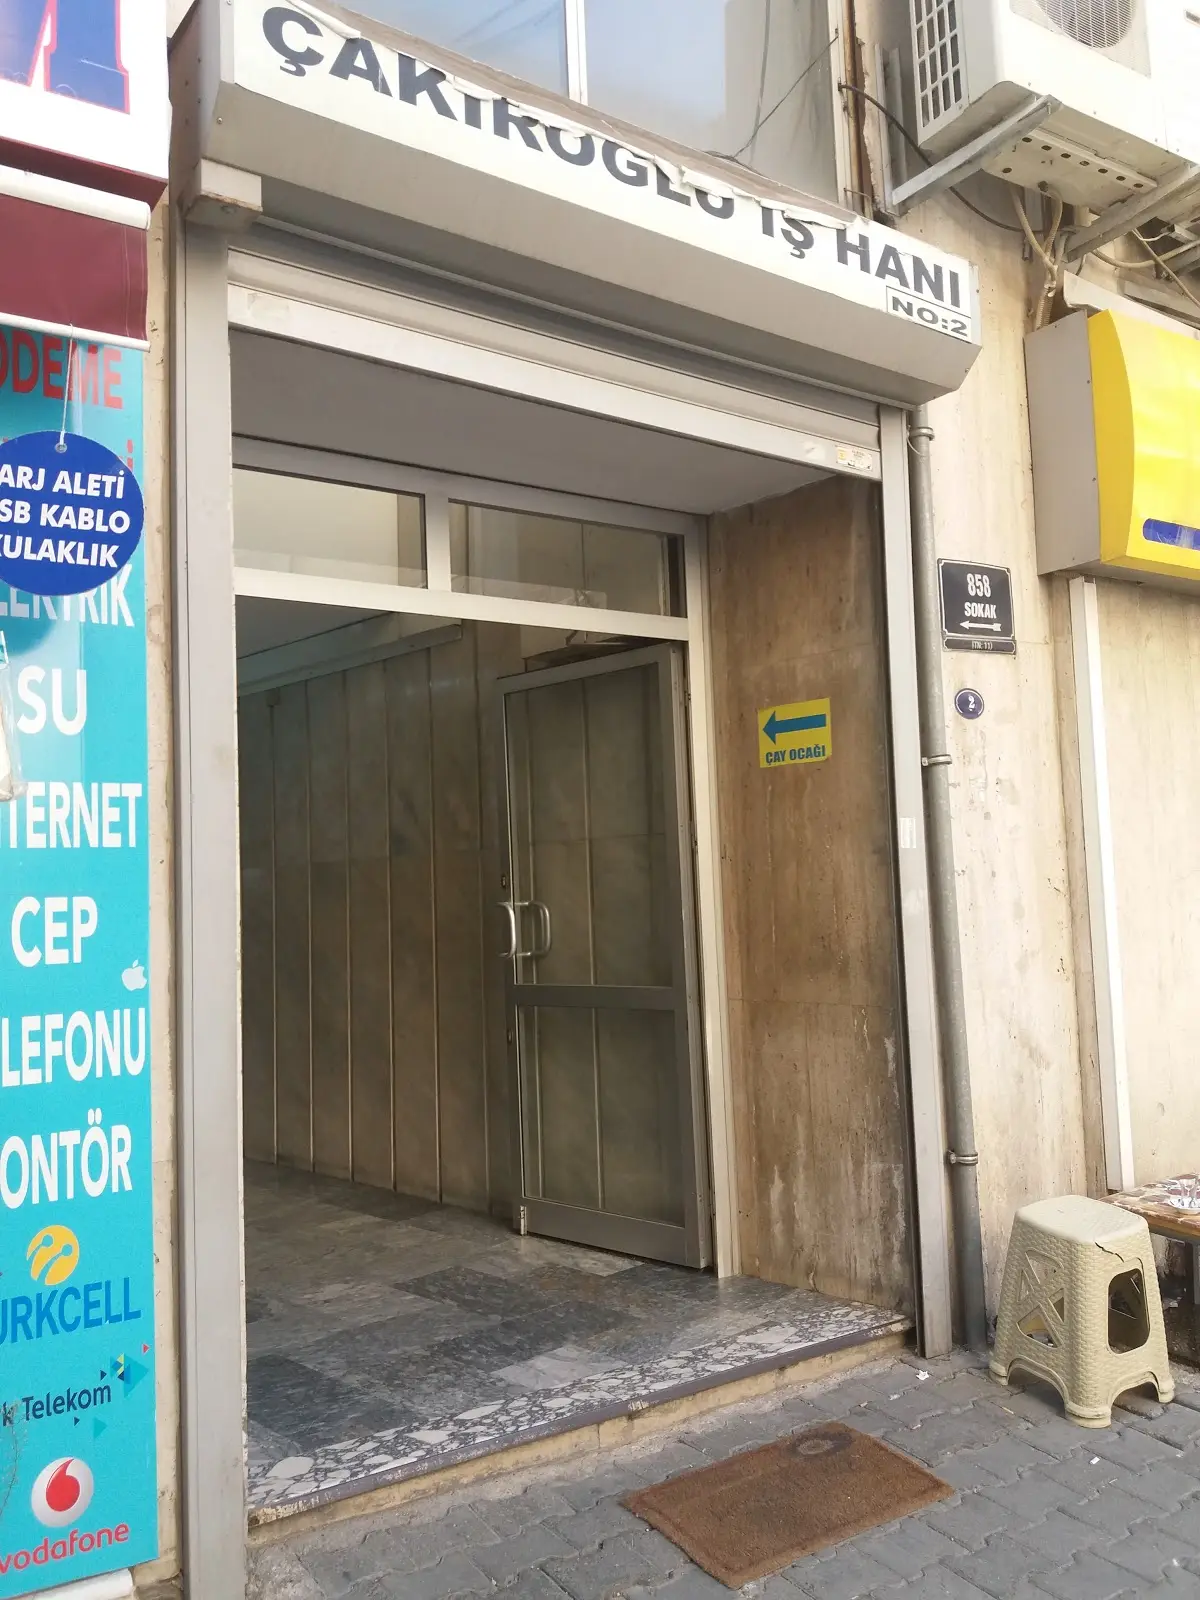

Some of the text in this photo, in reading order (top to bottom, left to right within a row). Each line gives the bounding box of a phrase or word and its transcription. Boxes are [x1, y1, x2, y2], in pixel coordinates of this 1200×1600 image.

[836, 227, 961, 308] HANI
[891, 295, 968, 338] NO:2
[52, 469, 125, 499] ALETİ
[39, 503, 131, 534] KABLO
[0, 533, 120, 568] ULAKLIK
[966, 572, 992, 598] 858
[964, 601, 997, 619] SOKAK
[17, 664, 88, 736] SU
[765, 743, 826, 766] ÇAY OCAĞI
[0, 780, 142, 849] TERNET
[11, 895, 98, 968] CEP
[1, 1007, 146, 1088] LEFONU
[0, 1107, 133, 1209] ONTÖR
[22, 1384, 112, 1421] Telekom
